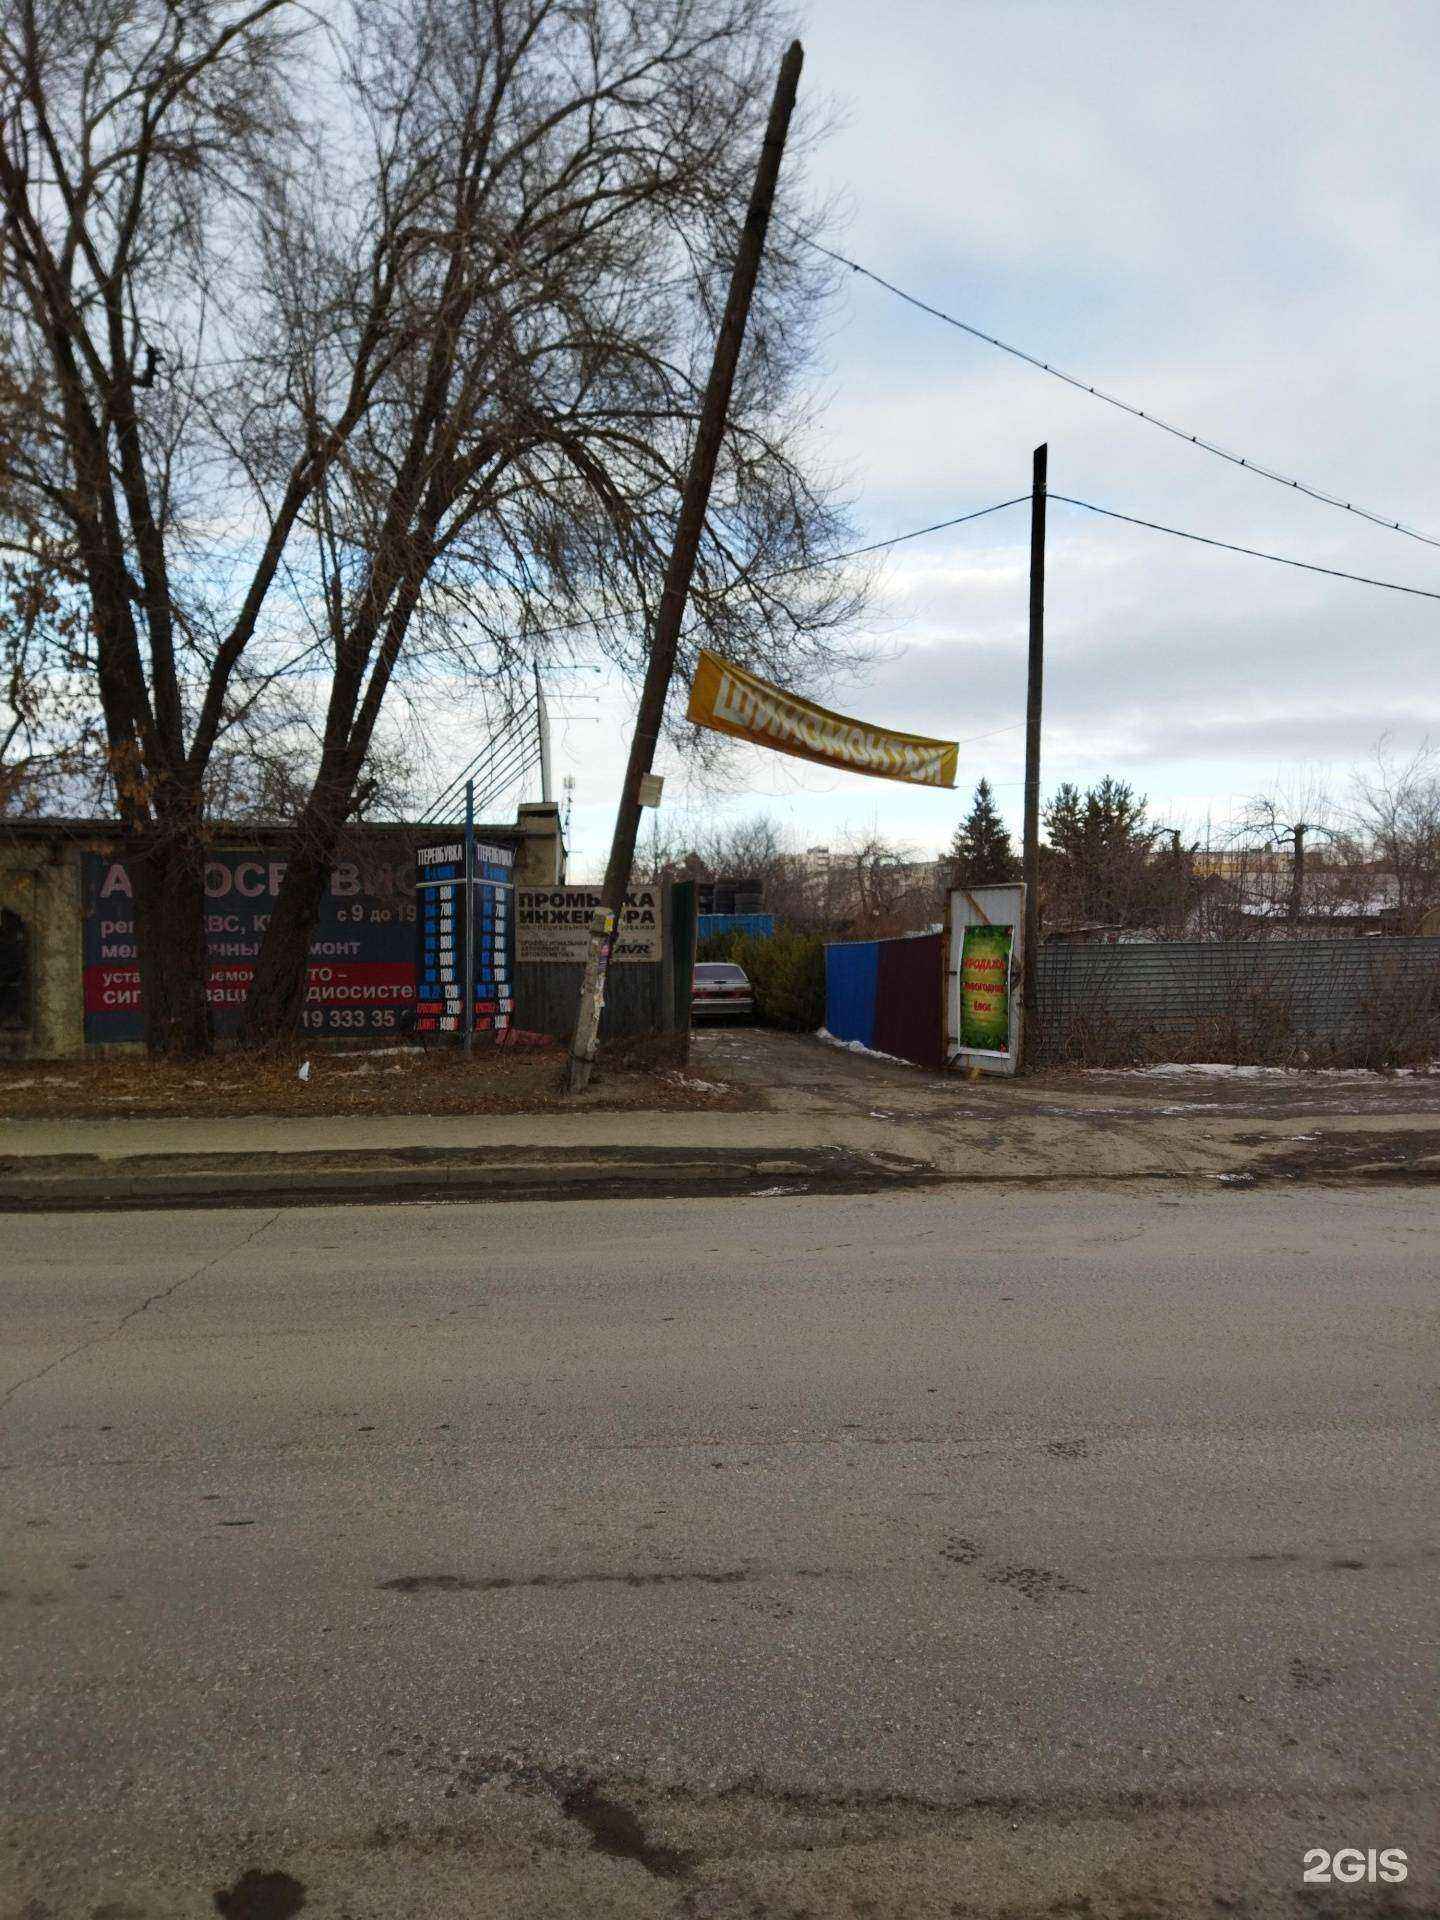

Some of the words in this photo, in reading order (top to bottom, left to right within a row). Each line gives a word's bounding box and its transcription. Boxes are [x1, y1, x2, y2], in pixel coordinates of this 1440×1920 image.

[352, 904, 363, 920] 9
[329, 1010, 365, 1027] 333
[371, 1010, 396, 1027] 35
